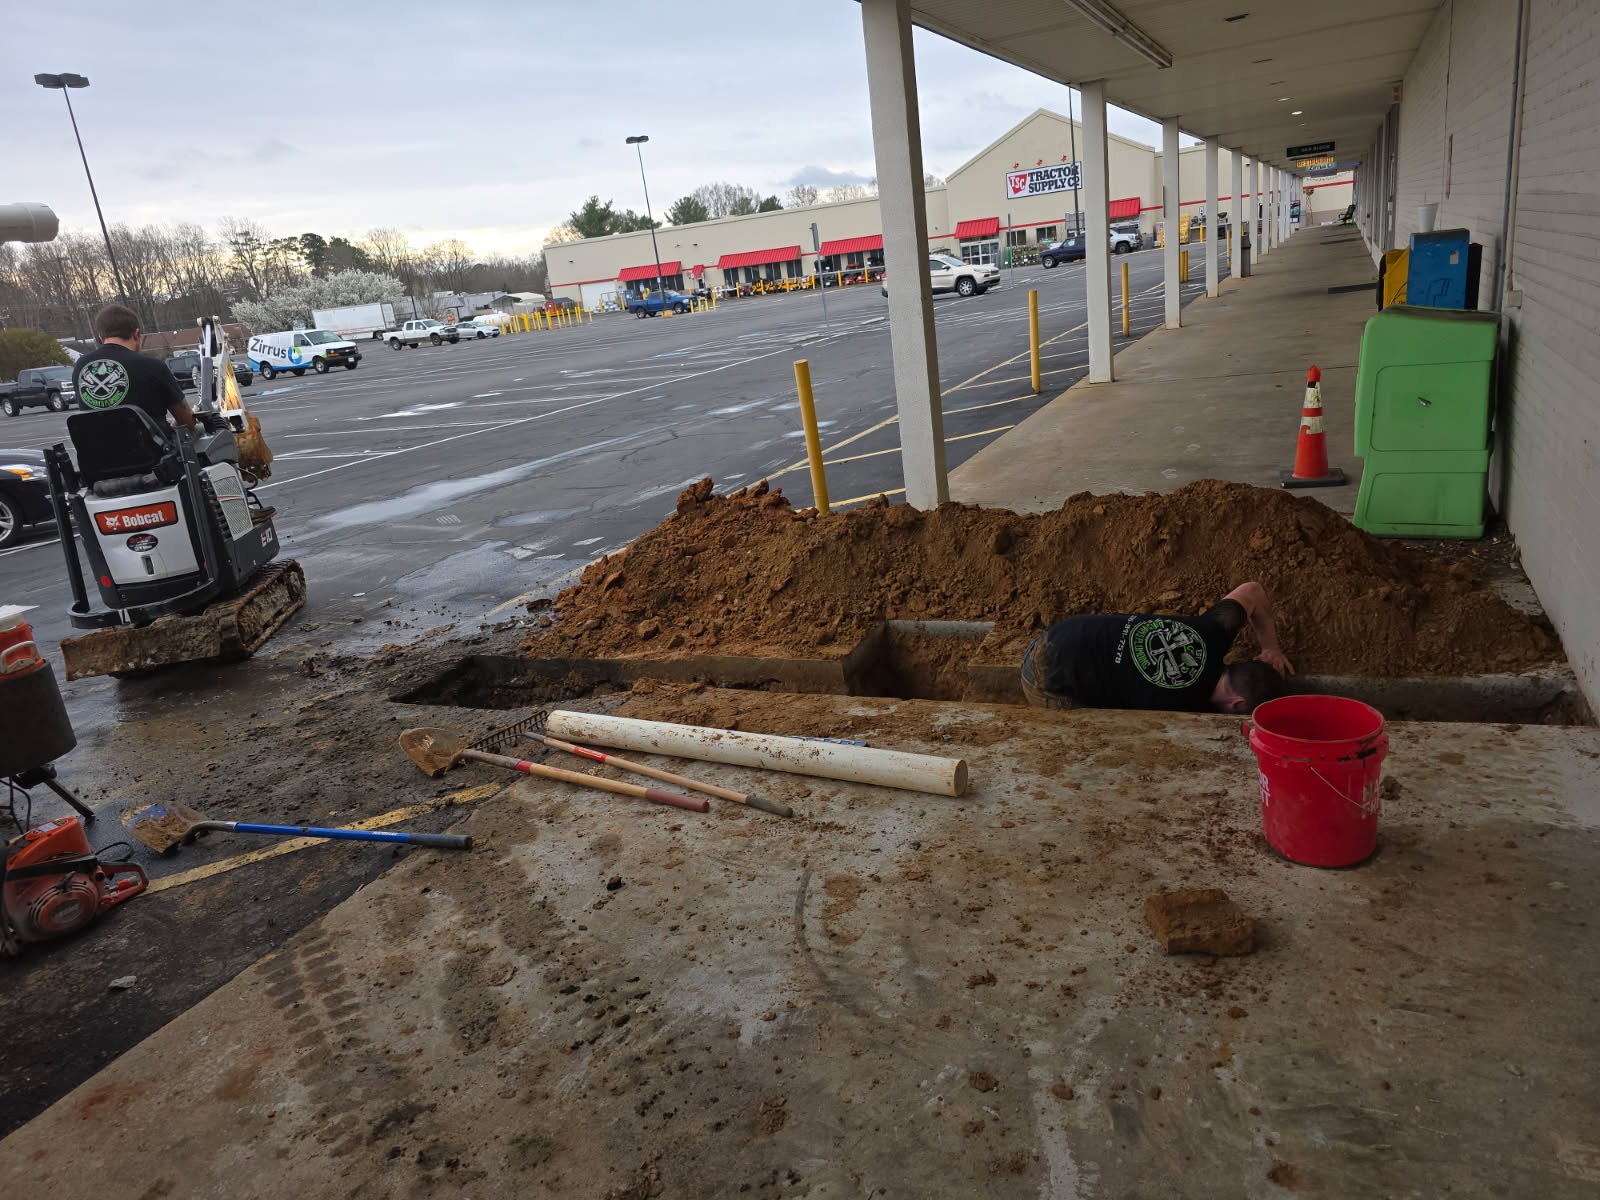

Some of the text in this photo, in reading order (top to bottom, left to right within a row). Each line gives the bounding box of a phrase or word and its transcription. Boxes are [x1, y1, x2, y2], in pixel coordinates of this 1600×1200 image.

[1028, 164, 1079, 182] TRACTOR
[1011, 176, 1025, 190] TSC
[1028, 178, 1067, 193] SUPPLY
[250, 338, 287, 359] Zirrus
[122, 510, 165, 528] Bobcat
